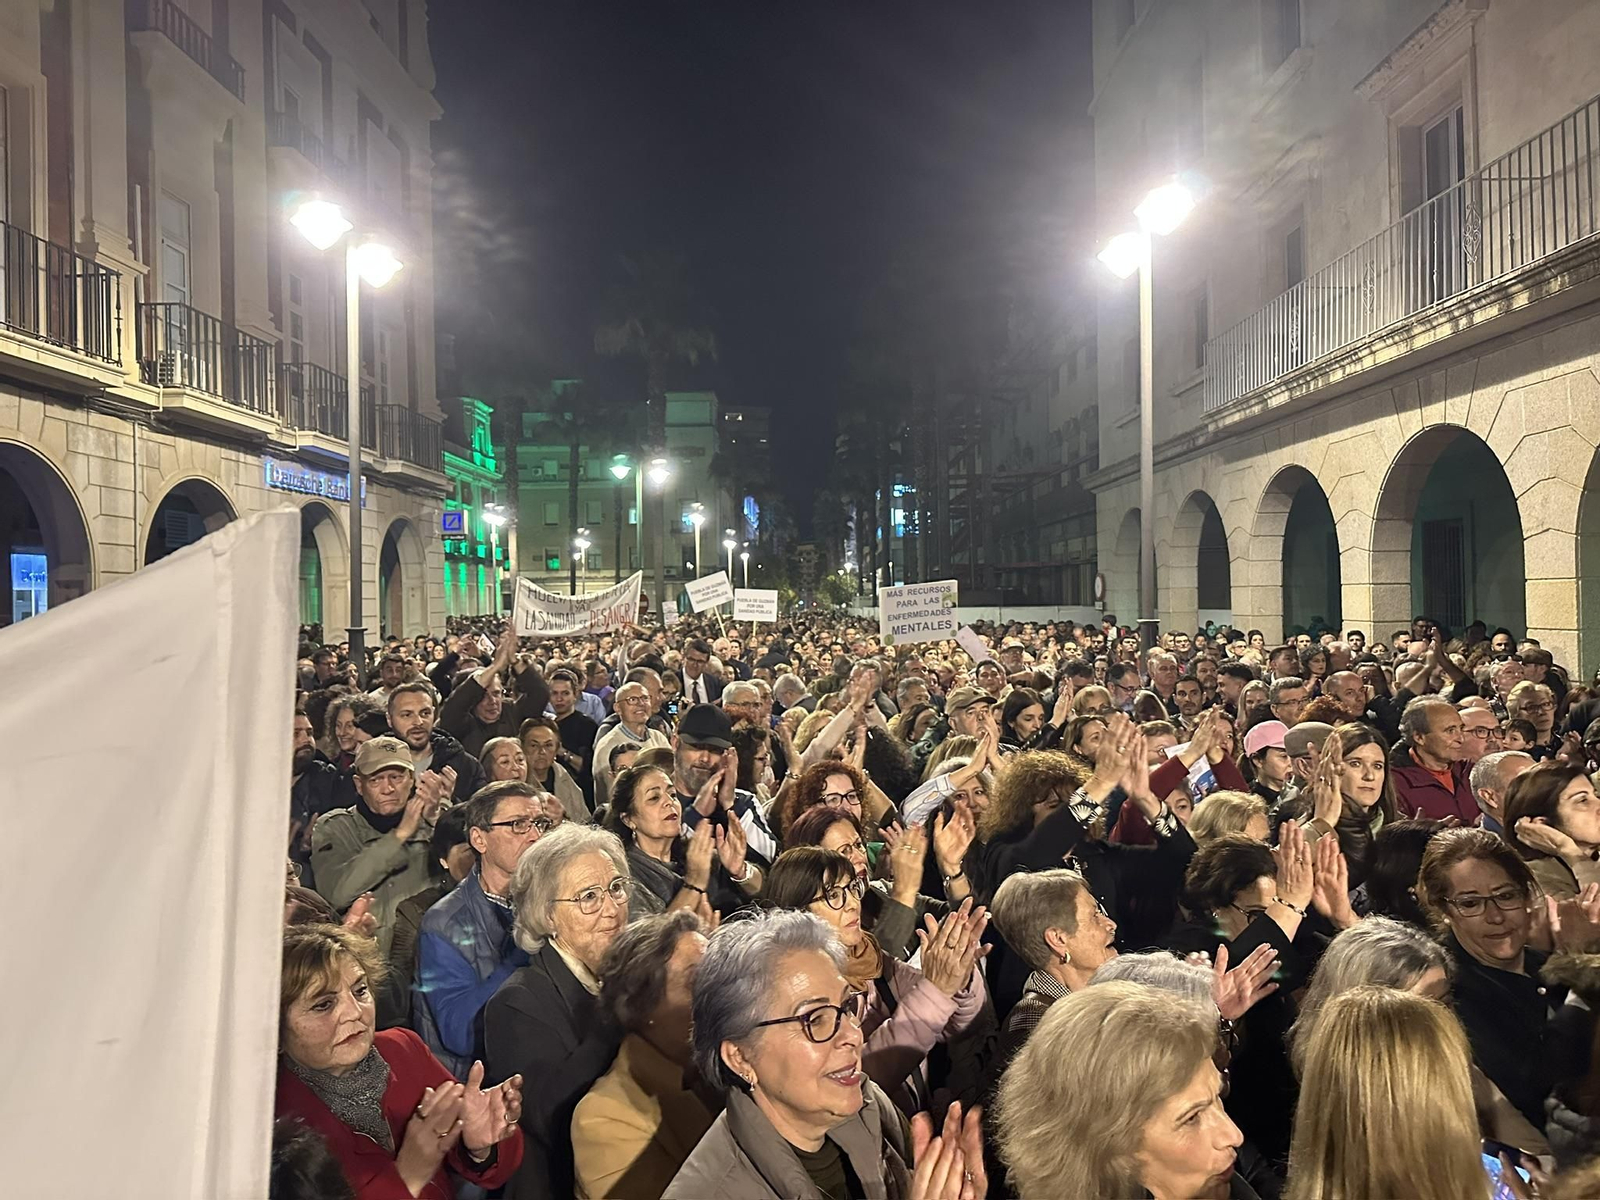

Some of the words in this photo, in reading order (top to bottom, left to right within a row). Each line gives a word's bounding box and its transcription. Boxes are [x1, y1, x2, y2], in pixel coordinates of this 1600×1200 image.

[907, 586, 951, 596] RECURSOS
[896, 599, 918, 608] PARA
[924, 596, 940, 605] LAS
[525, 609, 536, 630] LA
[538, 610, 576, 631] SANIDAD
[887, 609, 952, 621] ENFERMEDADES
[891, 620, 952, 635] MENTALES
